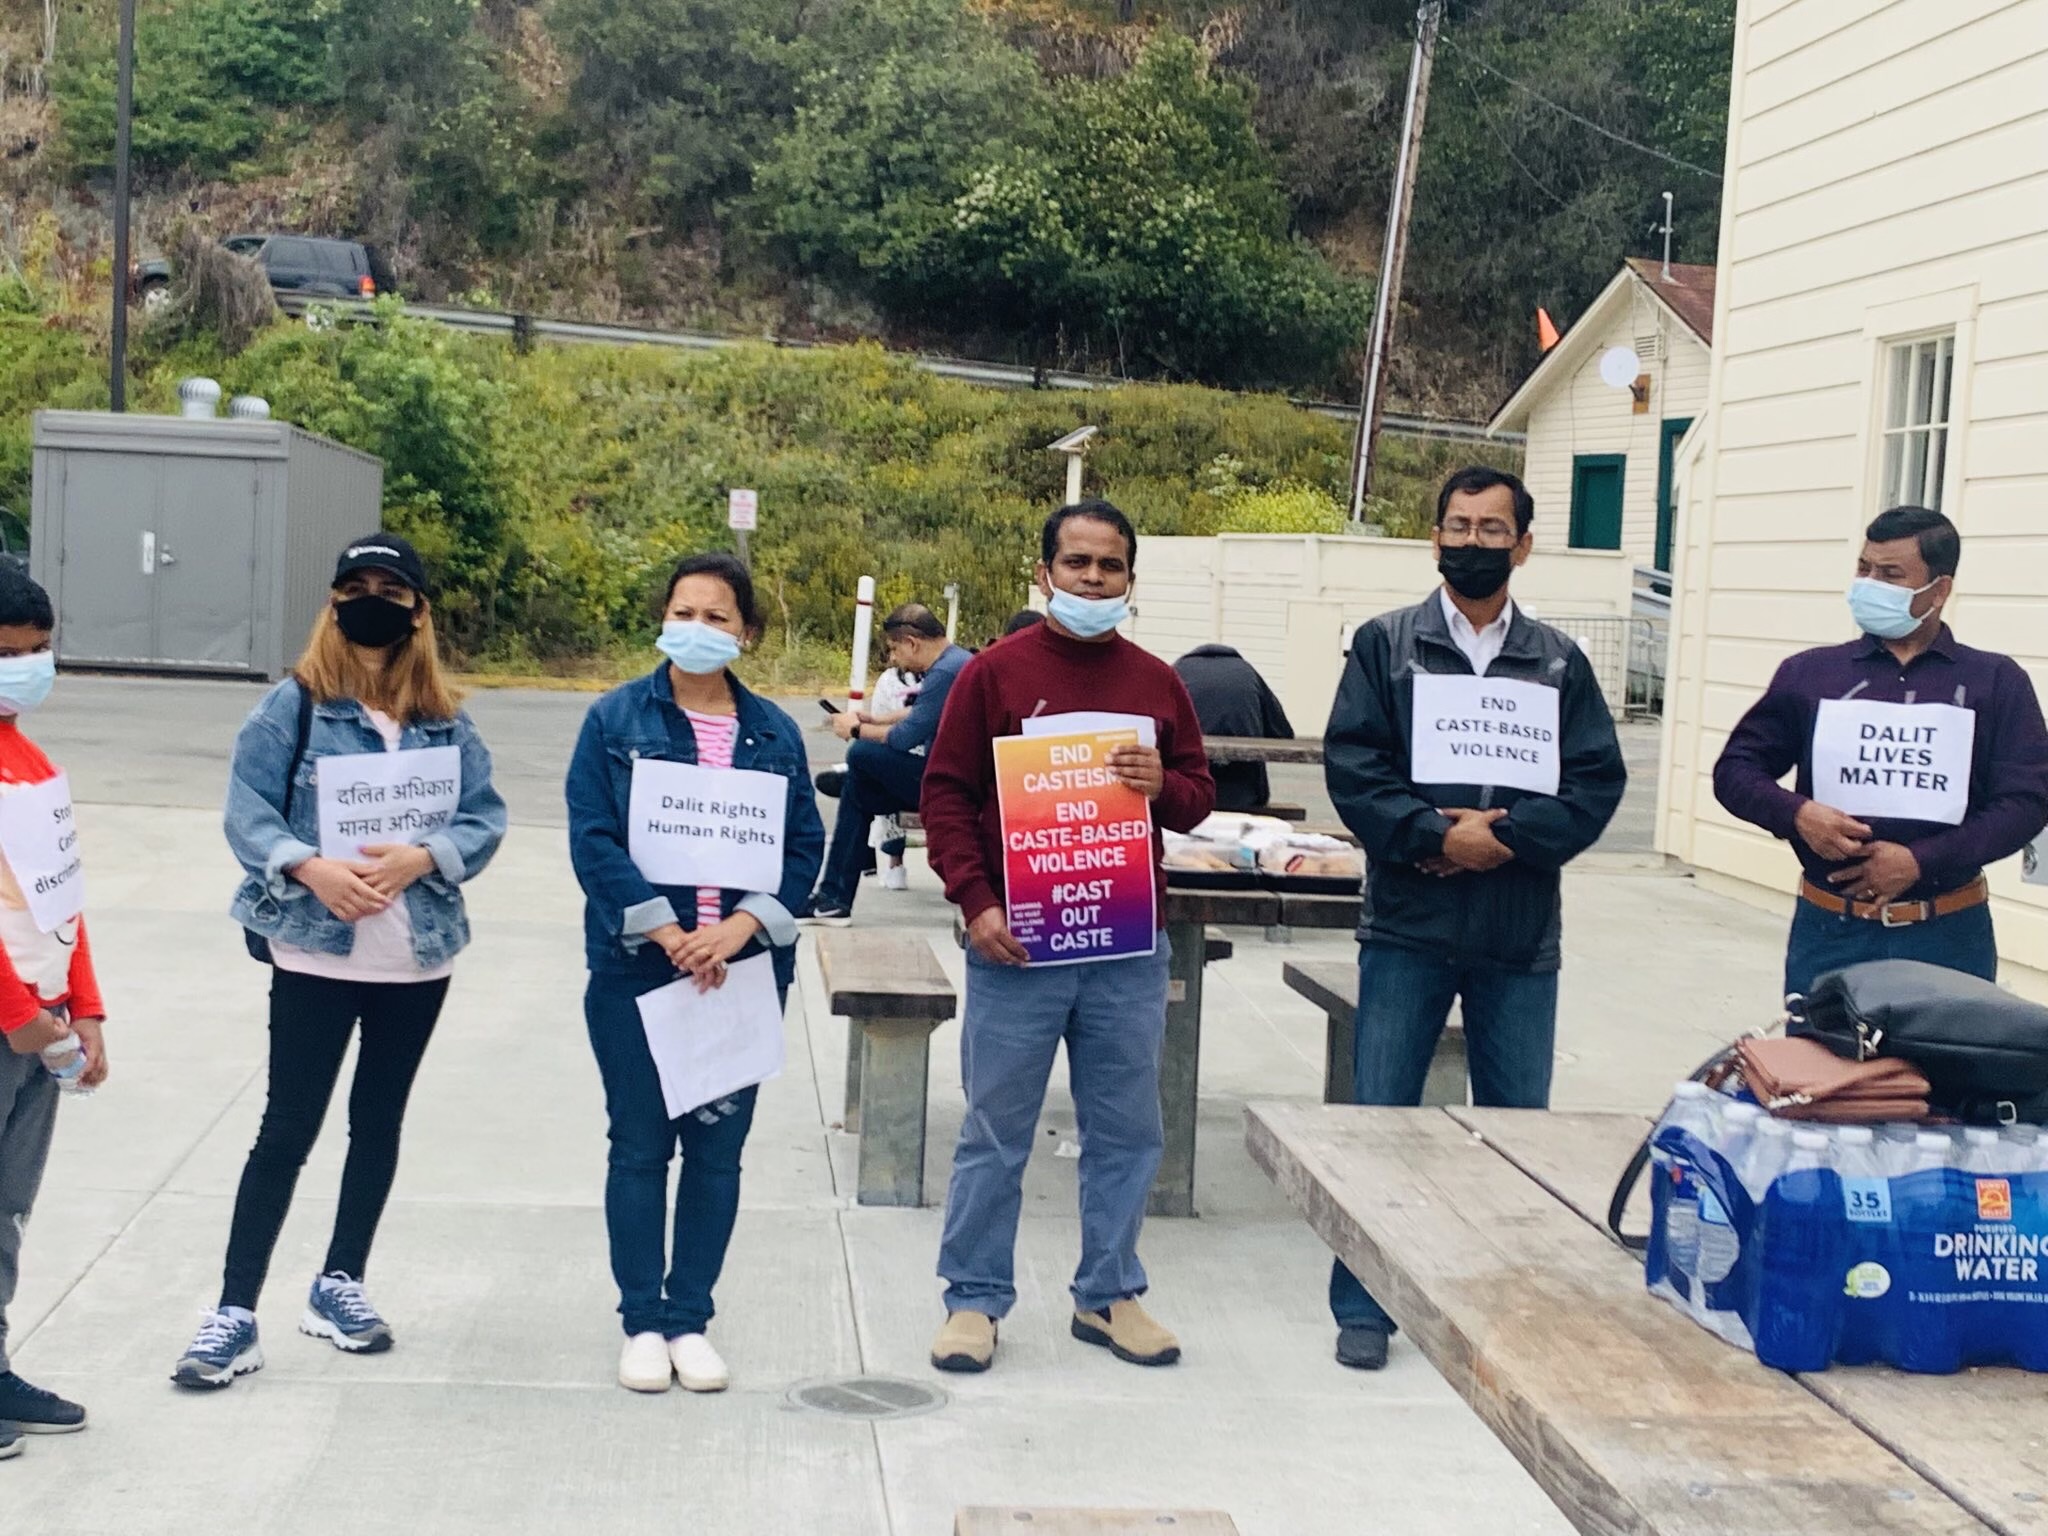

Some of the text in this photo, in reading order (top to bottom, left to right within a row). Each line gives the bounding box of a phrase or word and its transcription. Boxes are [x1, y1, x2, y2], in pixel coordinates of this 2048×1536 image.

[1480, 696, 1517, 713] END
[1435, 717, 1553, 742] CASTE-BASED
[1859, 723, 1937, 745] DALIT
[1049, 743, 1093, 766] END
[1450, 743, 1541, 764] VIOLENCE
[1858, 745, 1933, 767] LIVES
[337, 776, 455, 806] दलित अधिकार
[1839, 766, 1949, 793] MATTER
[661, 795, 768, 820] Dalit Rights
[1055, 799, 1099, 823] END
[337, 808, 449, 837] मानव अधिकार
[648, 818, 776, 846] Human Rights
[1009, 820, 1147, 852] CASTE-BASED
[1028, 846, 1128, 875] VIOLENCE
[1051, 879, 1114, 905] #CAST
[1060, 905, 1102, 927] OUT
[1050, 927, 1114, 952] CASTE
[1851, 1191, 1881, 1209] 35
[1954, 1257, 2039, 1281] WATER
